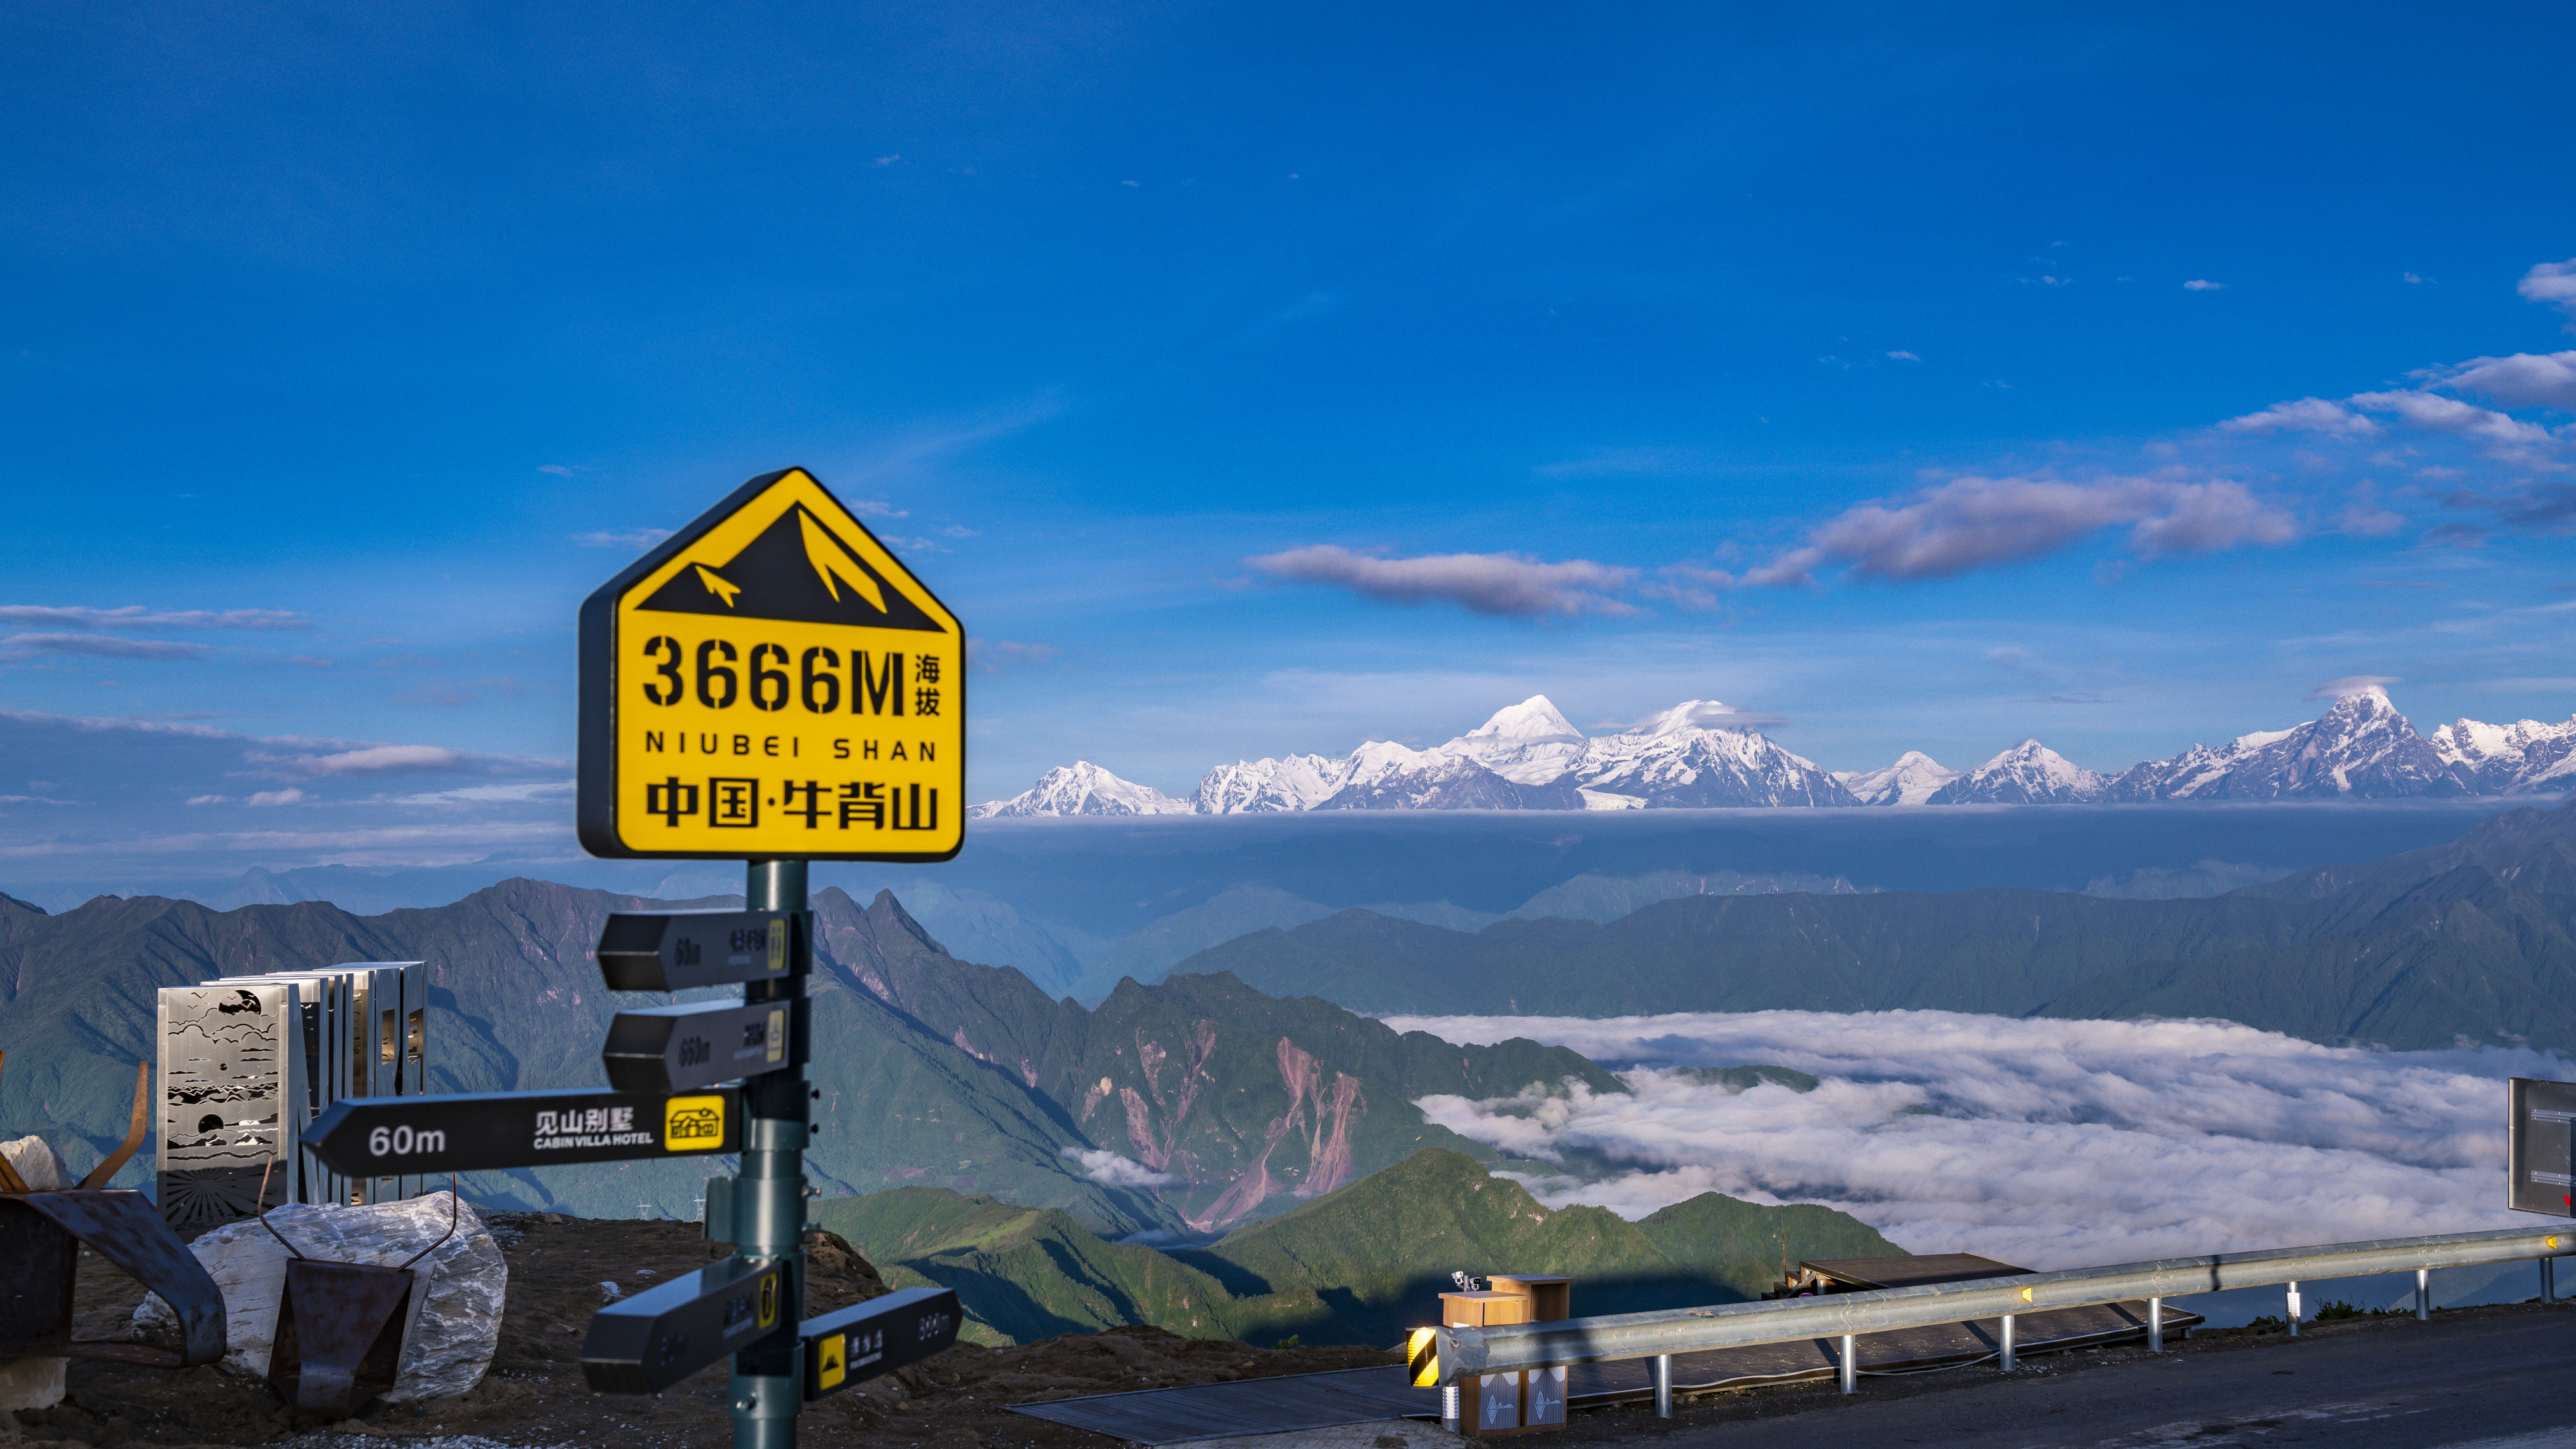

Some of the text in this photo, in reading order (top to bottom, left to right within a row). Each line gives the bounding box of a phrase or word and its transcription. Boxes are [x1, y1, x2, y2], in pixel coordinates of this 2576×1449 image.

[643, 635, 904, 716] 3666M
[915, 653, 941, 717] 海拔
[646, 731, 935, 762] NIUBEI SHAN
[646, 776, 938, 831] 中国·牛背山
[535, 1106, 634, 1136] 见山别墅
[369, 1126, 445, 1156] 60m
[533, 1132, 654, 1150] CABIN VILLA HOTEL
